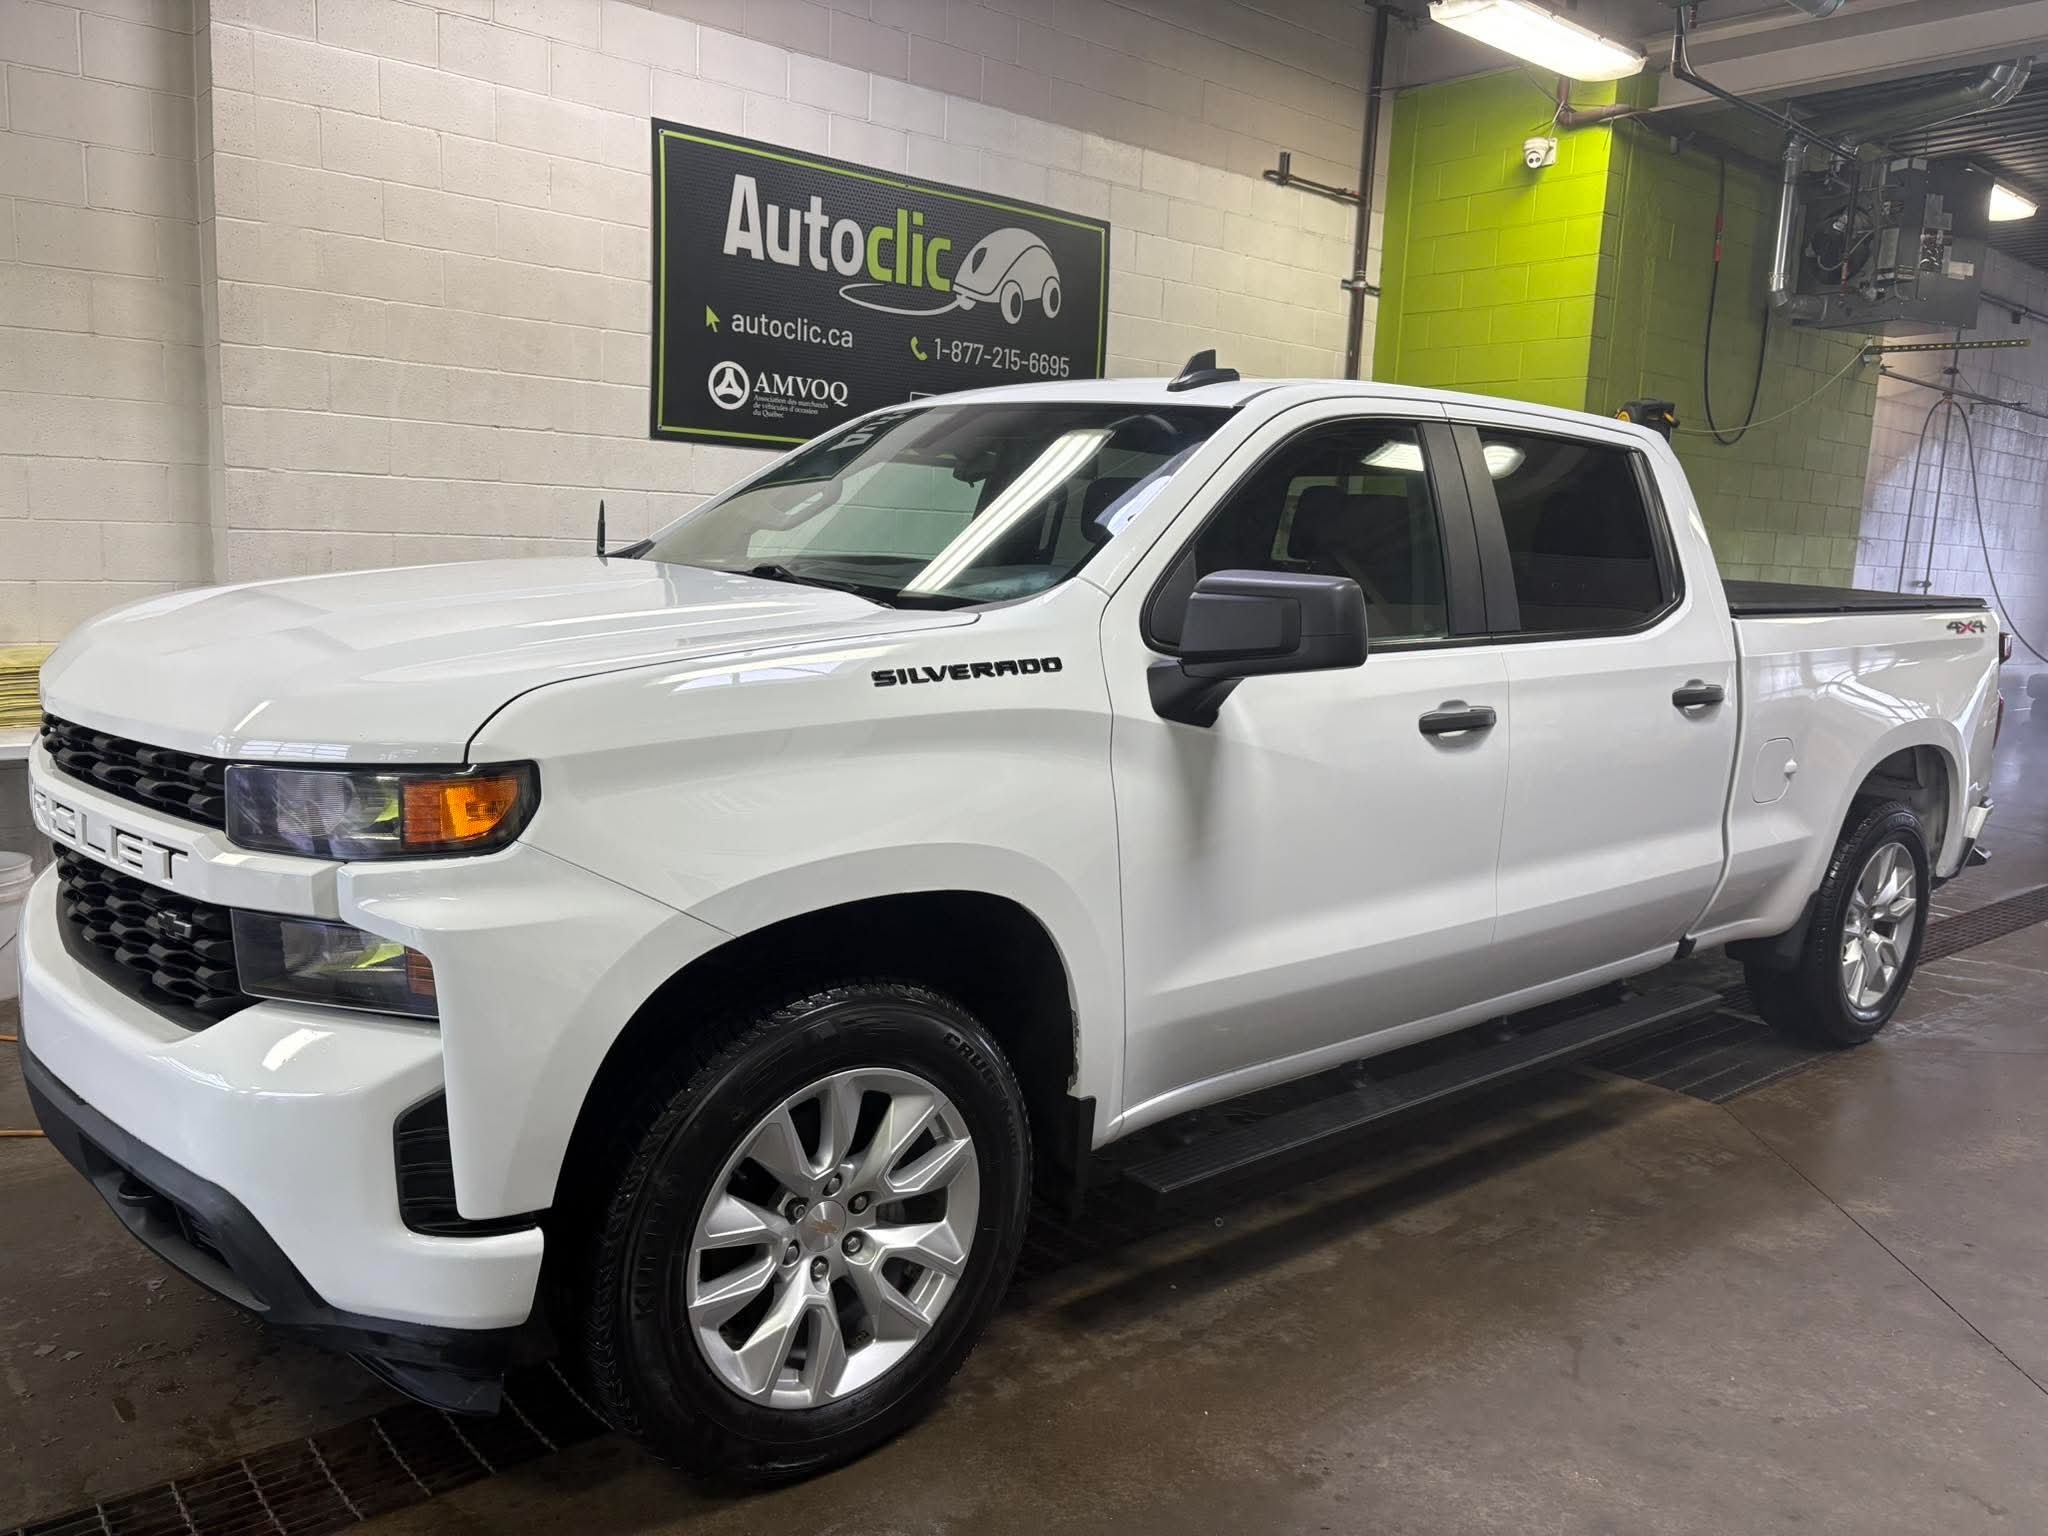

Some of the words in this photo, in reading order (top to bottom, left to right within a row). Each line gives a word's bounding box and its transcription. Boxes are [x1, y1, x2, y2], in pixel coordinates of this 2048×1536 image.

[723, 174, 951, 292] Autoclic
[731, 312, 853, 348] autoclic.ca
[934, 337, 1070, 378] 1-877-215-6695
[753, 371, 848, 407] AMVOQ
[871, 656, 1063, 687] SILVERADO
